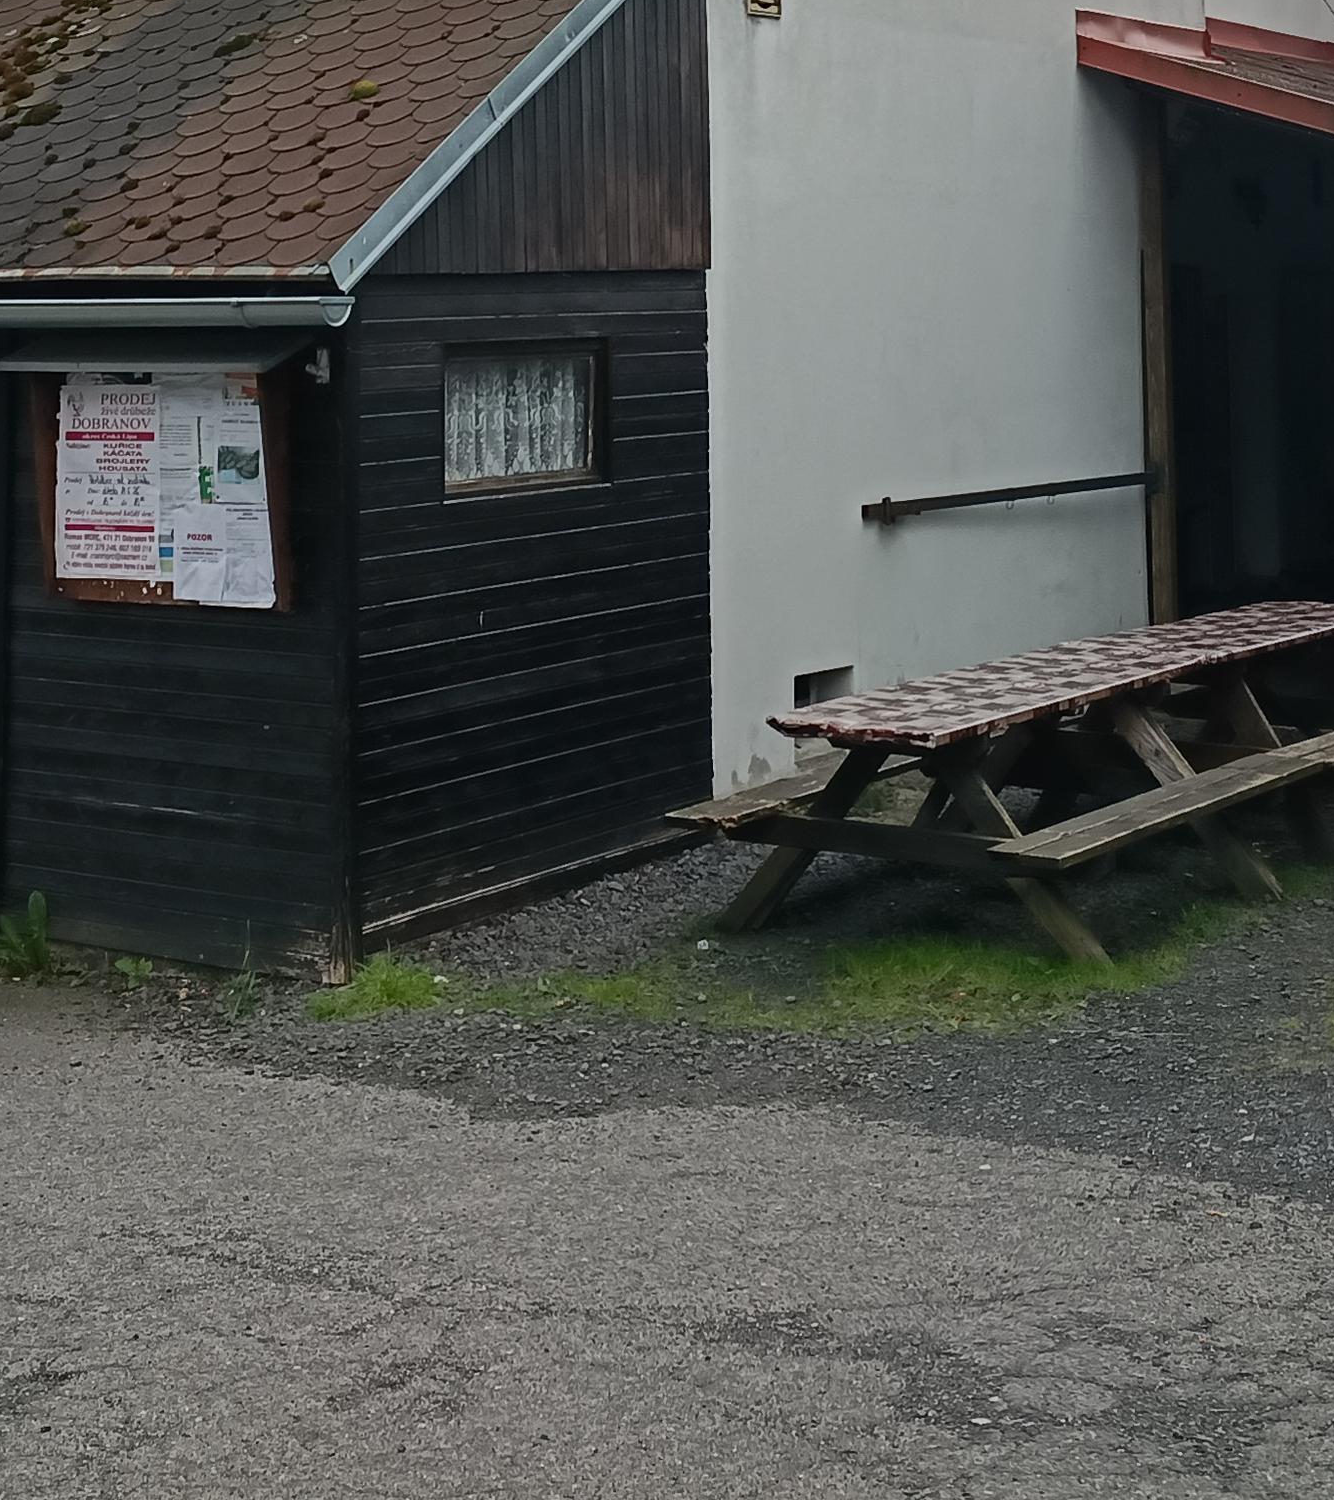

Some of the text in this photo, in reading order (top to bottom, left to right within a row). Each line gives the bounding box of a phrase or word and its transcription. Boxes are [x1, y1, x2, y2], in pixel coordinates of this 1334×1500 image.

[100, 393, 156, 405] PRODEJ
[71, 417, 151, 430] DOBRANOV
[187, 533, 213, 541] POZOR
